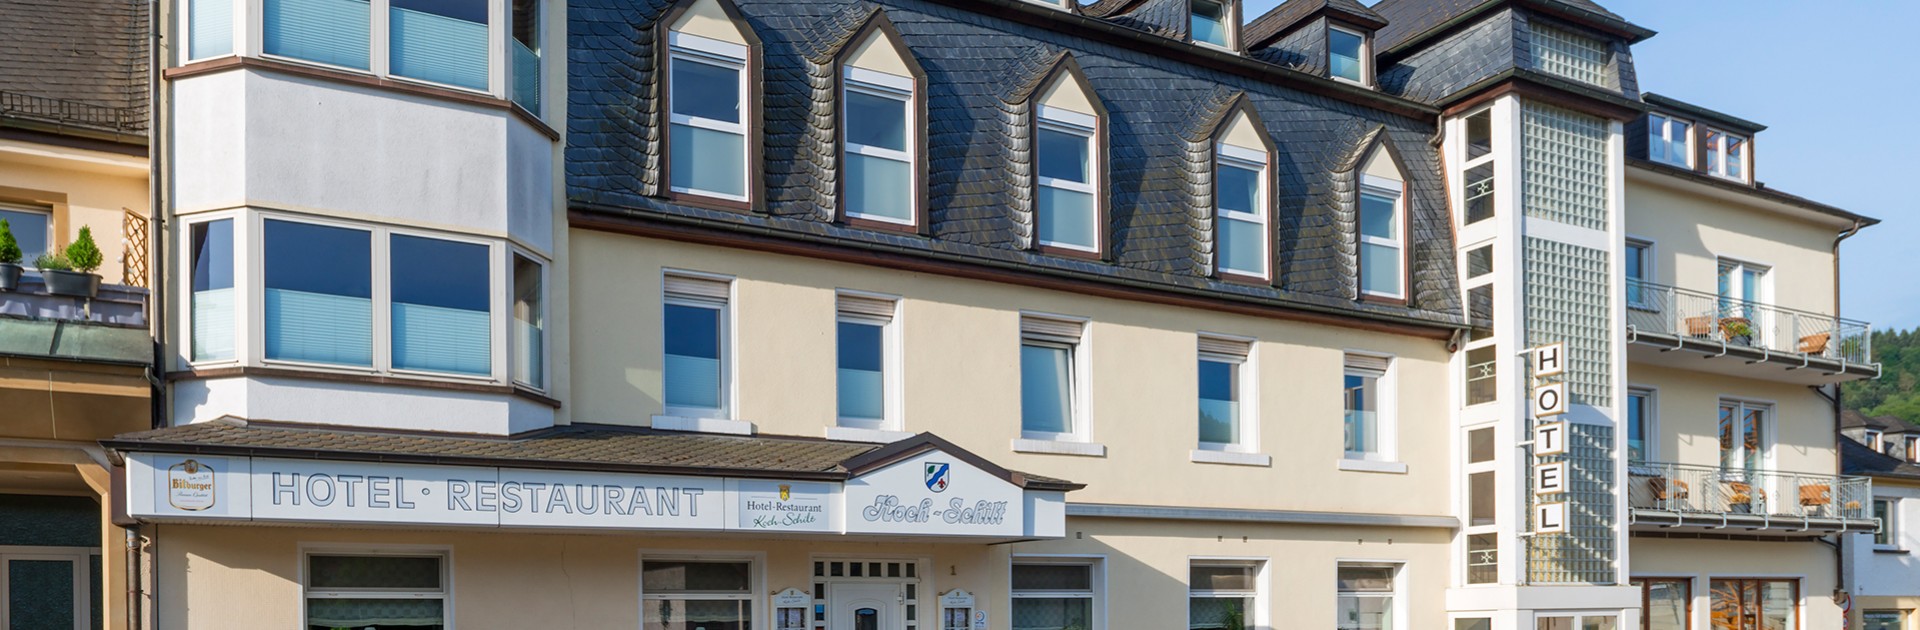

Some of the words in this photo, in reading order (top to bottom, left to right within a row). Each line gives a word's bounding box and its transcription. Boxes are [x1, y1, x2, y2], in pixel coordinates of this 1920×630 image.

[1539, 347, 1559, 529] HOTEL
[272, 472, 415, 509] HOTEL
[447, 479, 704, 517] RESTAURANT
[747, 501, 822, 512] Hotel-Restaurant
[950, 565, 957, 576] 1
